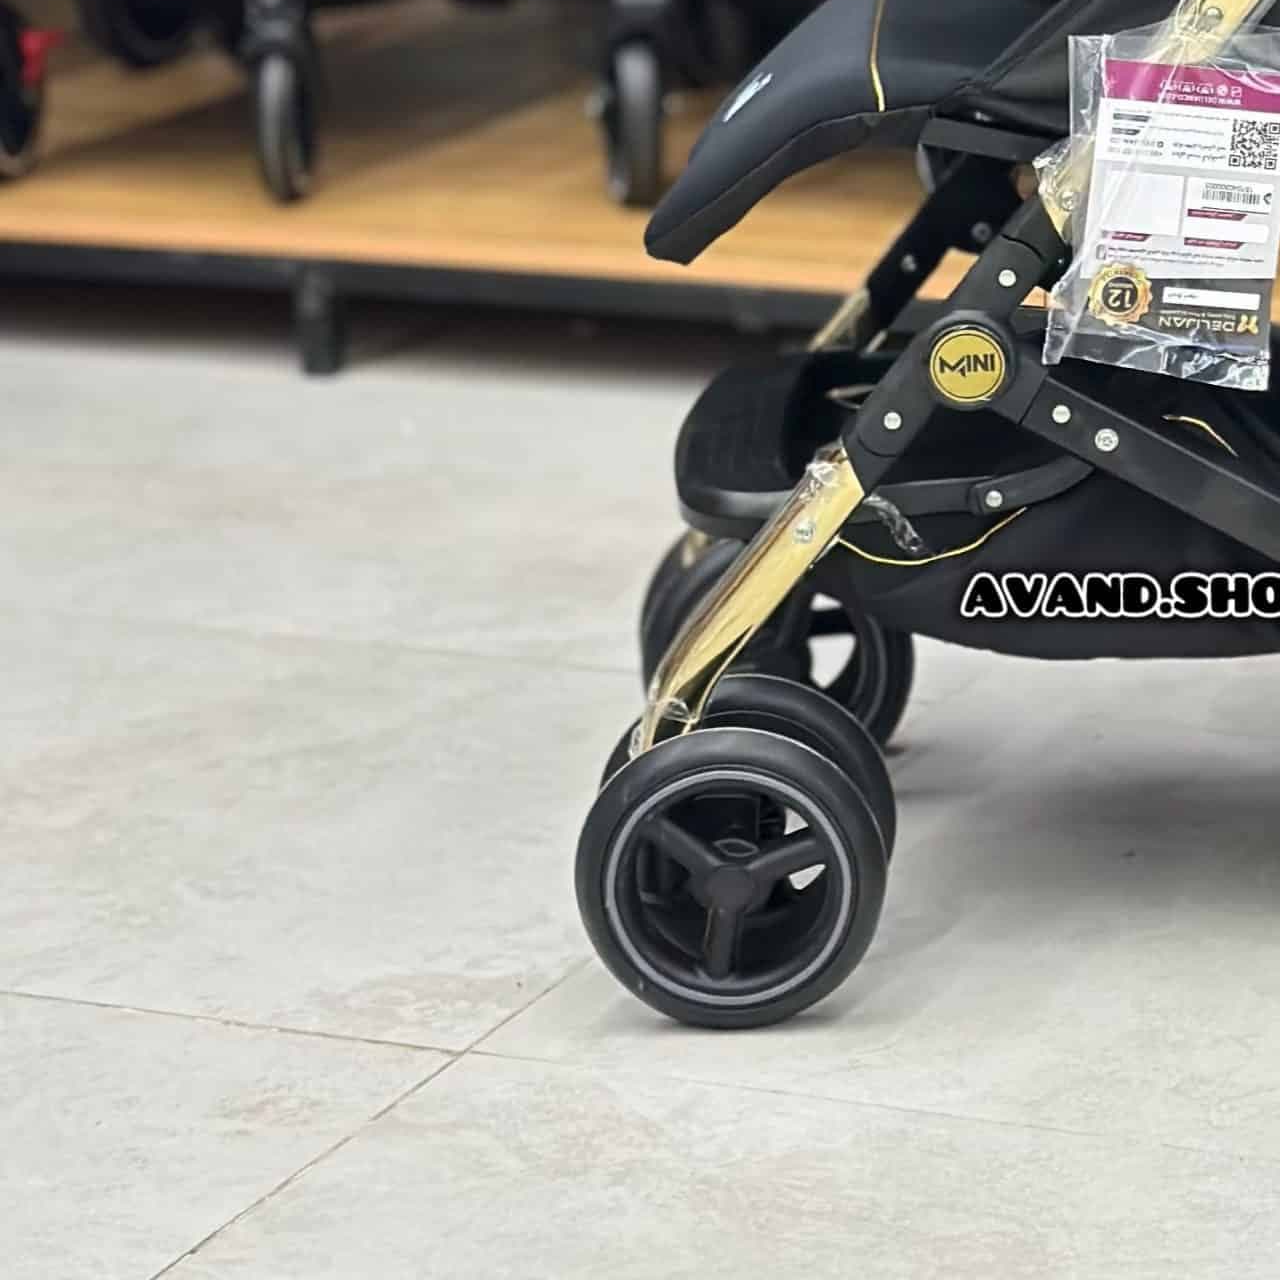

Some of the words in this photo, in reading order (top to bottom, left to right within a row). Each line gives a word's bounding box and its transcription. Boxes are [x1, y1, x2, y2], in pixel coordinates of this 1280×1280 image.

[1107, 289, 1132, 310] 12
[1159, 318, 1234, 333] DELIJAN
[939, 353, 996, 378] MINI
